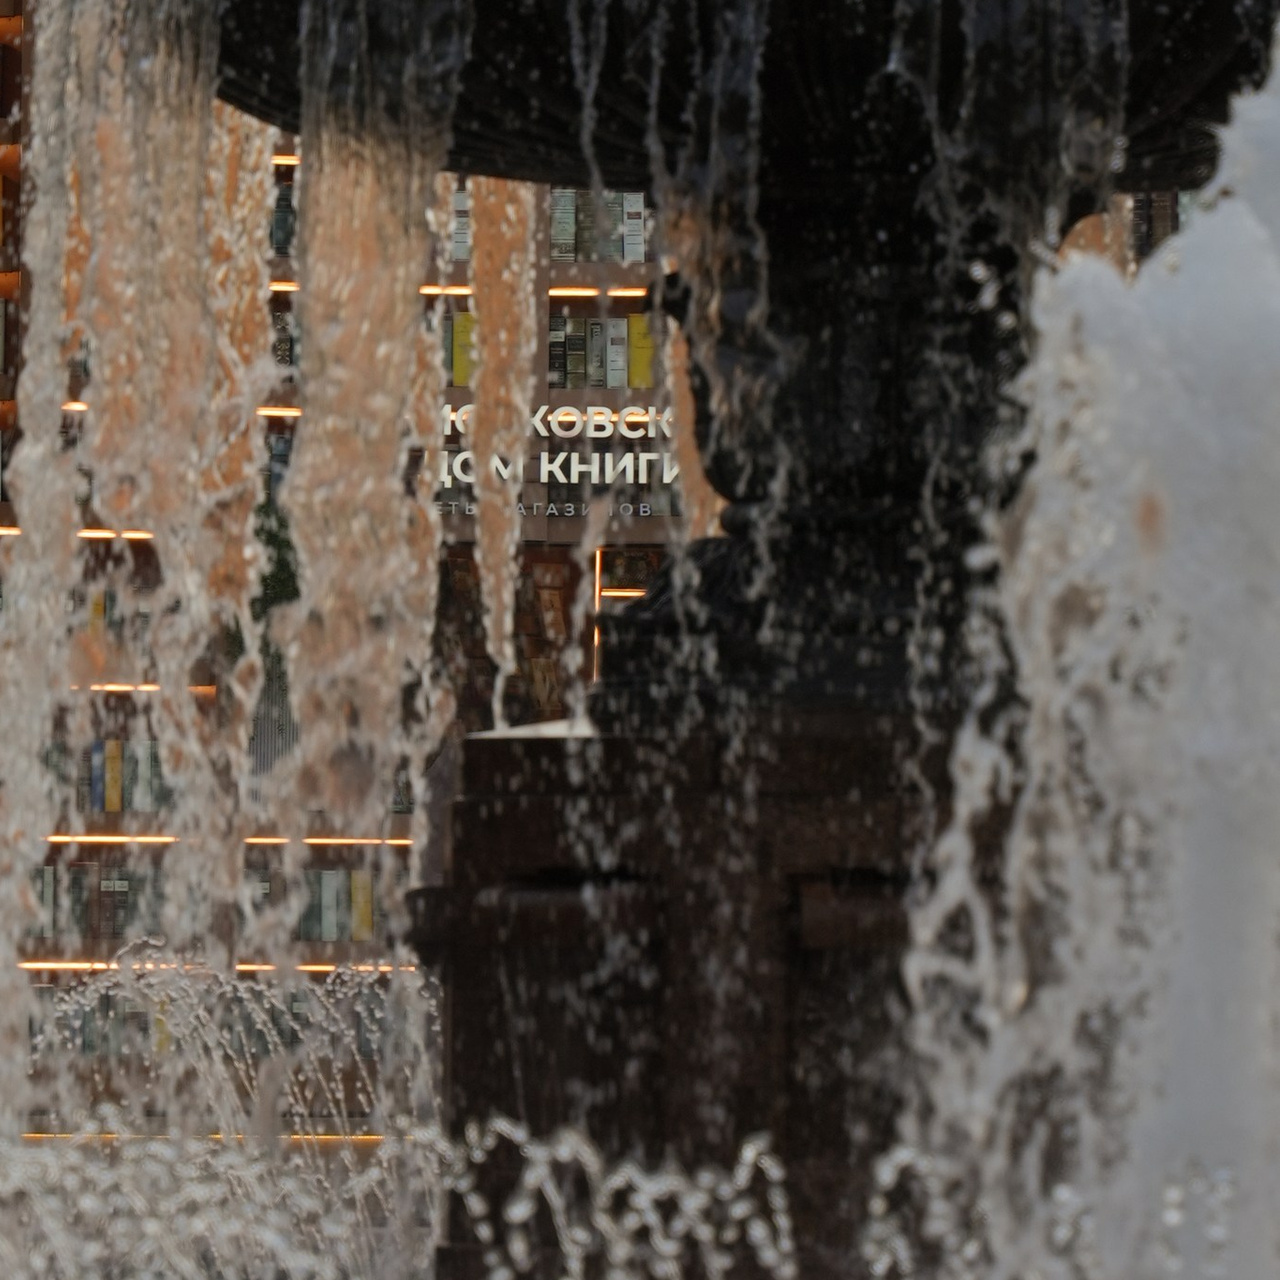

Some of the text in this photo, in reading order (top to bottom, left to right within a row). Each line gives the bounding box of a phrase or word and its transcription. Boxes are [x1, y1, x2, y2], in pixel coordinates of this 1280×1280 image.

[441, 404, 674, 439] ОКОВСК
[540, 452, 681, 484] КНИГИ
[434, 502, 652, 517] ЕТЬ АГАЗИОВ
